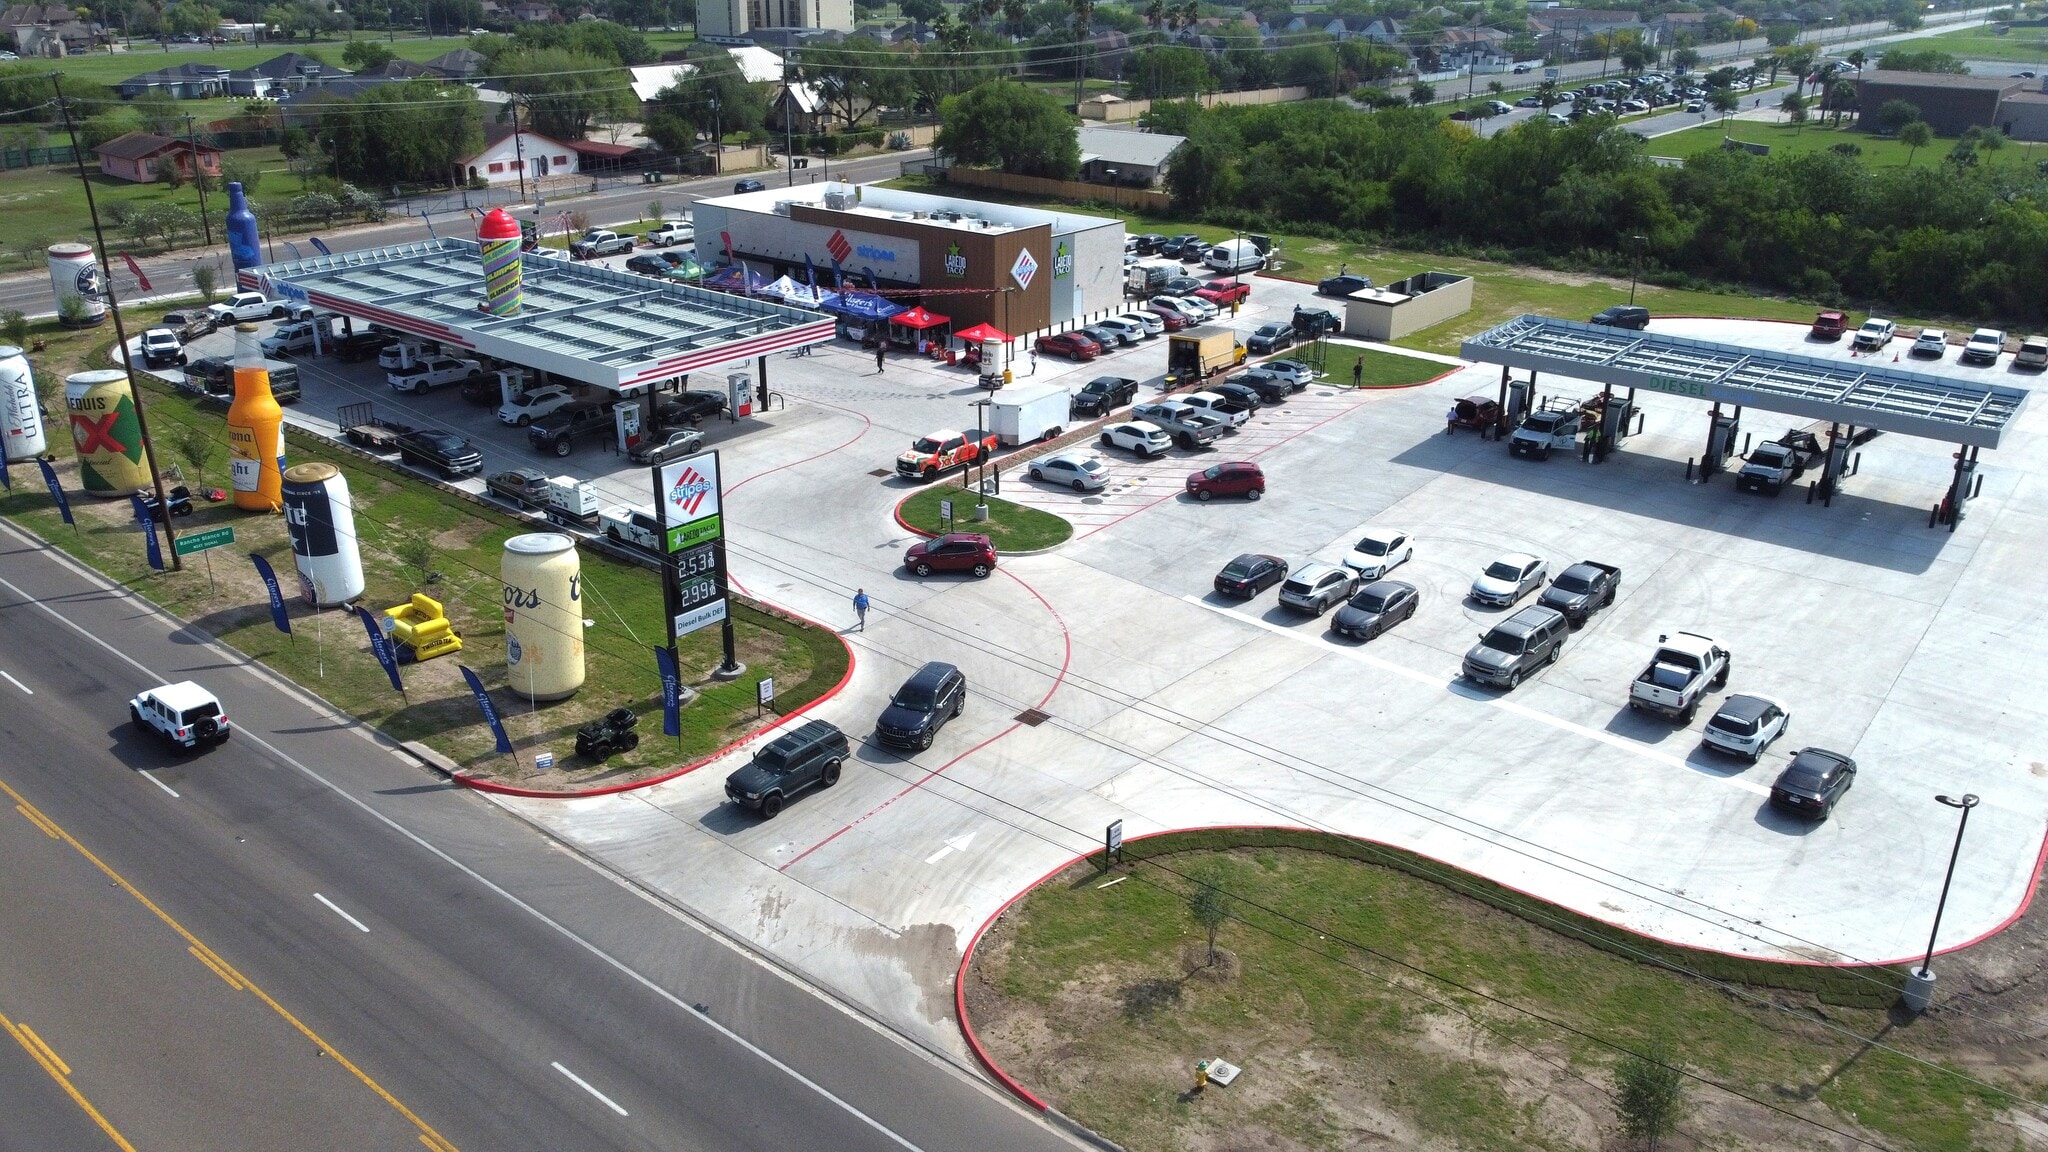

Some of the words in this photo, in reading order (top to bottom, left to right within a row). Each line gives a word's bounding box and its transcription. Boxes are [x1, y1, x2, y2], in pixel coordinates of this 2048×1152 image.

[857, 245, 896, 262] stripes
[945, 254, 967, 269] LAREDO
[1055, 255, 1071, 269] LAREDO
[948, 267, 964, 275] TACO
[1057, 266, 1070, 276] TACO
[489, 280, 519, 300] SLURPEE
[1649, 377, 1707, 397] DIESEL
[14, 372, 37, 439] ULTRA
[70, 397, 106, 411] EQUIS
[670, 480, 711, 502] stripes
[179, 537, 201, 546] Rancho
[201, 533, 220, 542] Blanco
[679, 528, 700, 543] LAREDO
[699, 523, 716, 534] TACO
[678, 553, 707, 579] 2.53
[681, 581, 709, 608] 2.99
[677, 617, 697, 630] Diesel
[697, 611, 712, 621] Bulk
[712, 606, 724, 616] DEF
[421, 639, 443, 651] TWISTED
